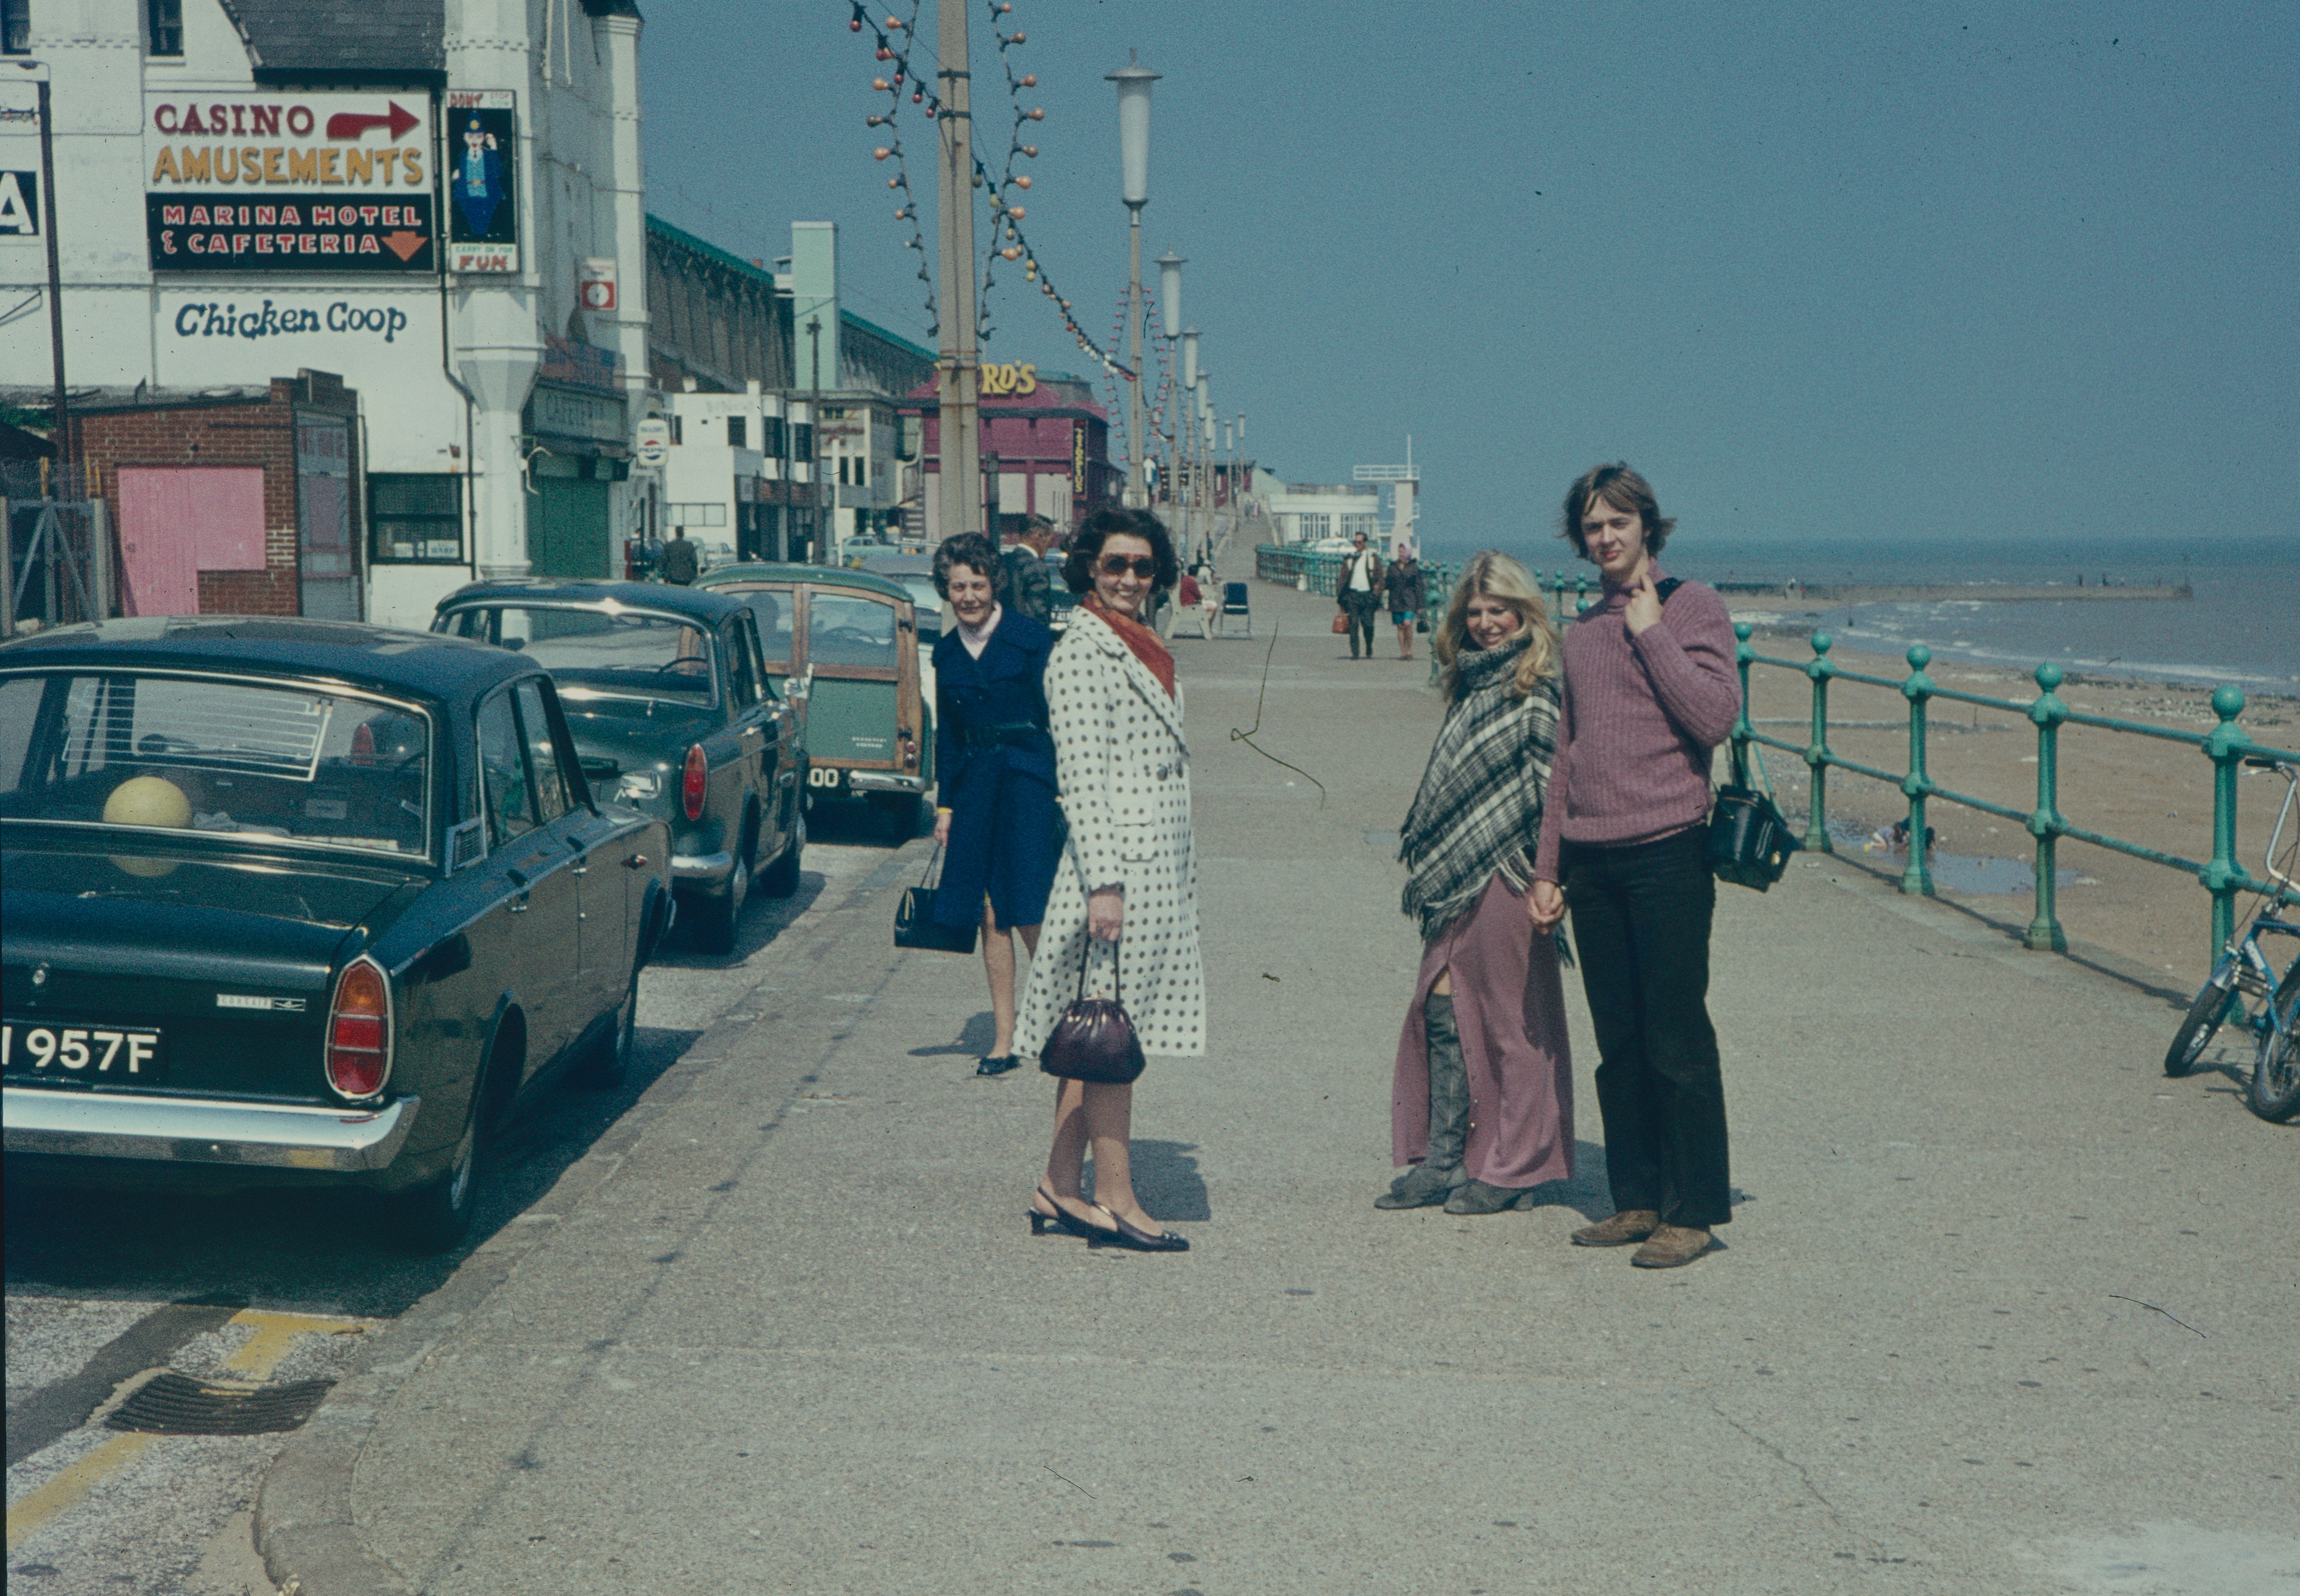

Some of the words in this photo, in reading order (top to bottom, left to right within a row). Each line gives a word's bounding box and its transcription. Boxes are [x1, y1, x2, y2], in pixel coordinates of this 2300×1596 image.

[154, 103, 315, 136] CASINO
[152, 146, 423, 185] AMUSEMENTS
[163, 205, 302, 226] MARINA
[312, 206, 422, 226] HOTEL
[161, 230, 178, 255] &
[188, 234, 381, 254] CAFETERIA
[459, 255, 507, 270] FUN
[175, 299, 321, 340] Chicken
[327, 301, 408, 343] Coop
[26, 1028, 157, 1073] 957F
